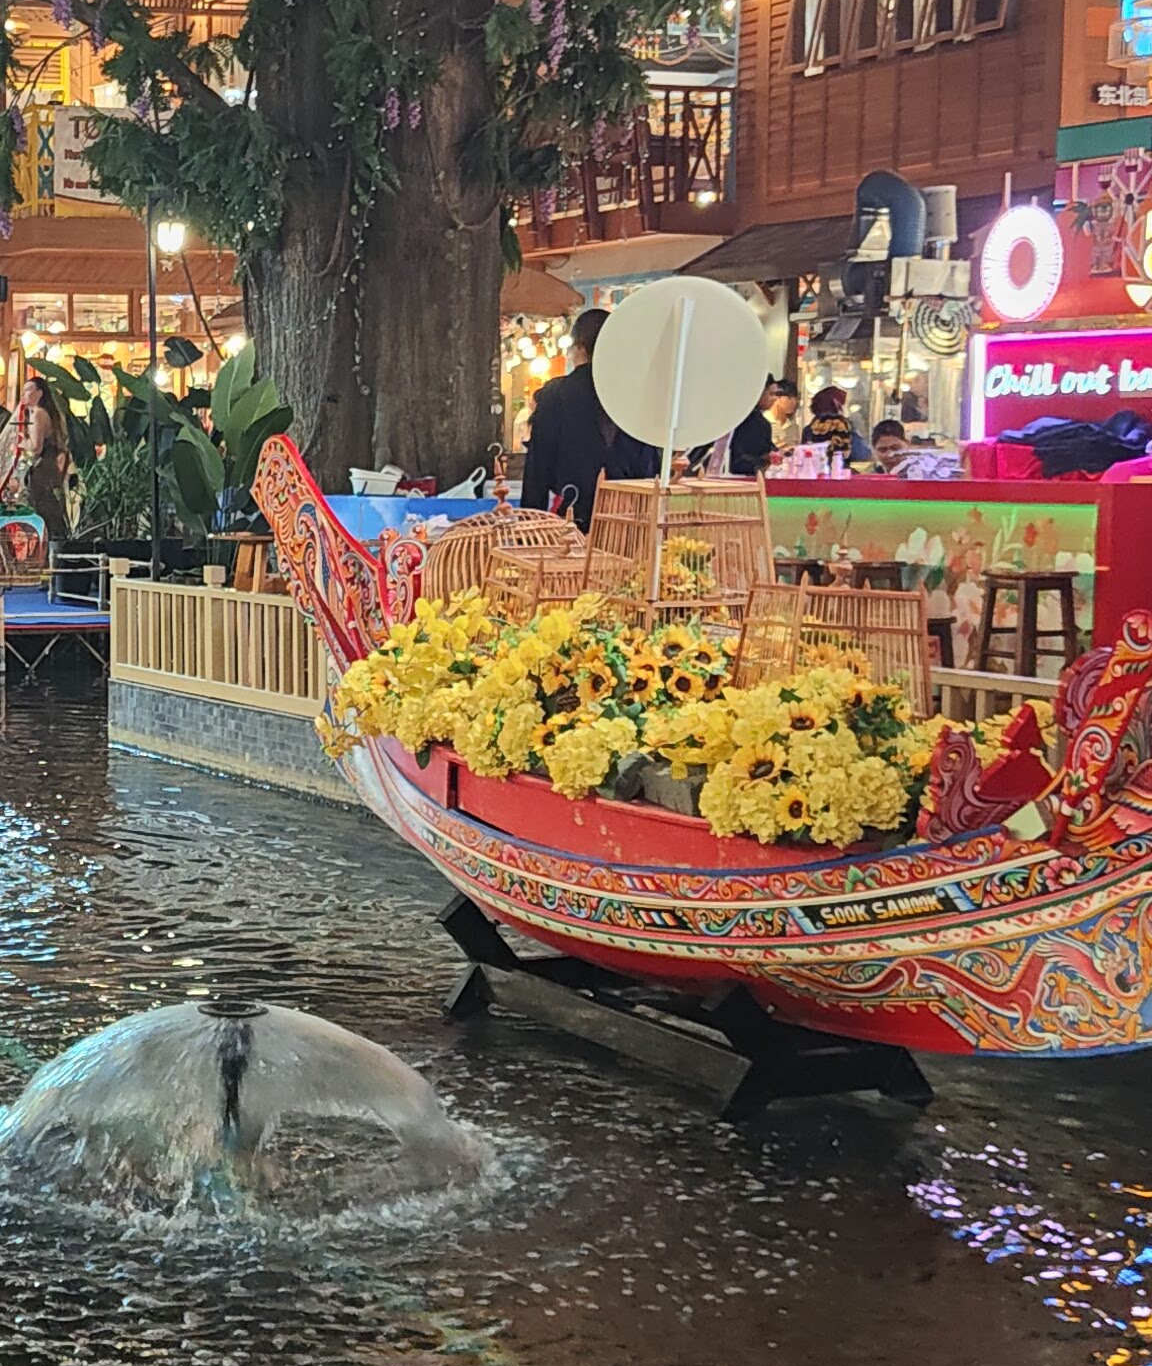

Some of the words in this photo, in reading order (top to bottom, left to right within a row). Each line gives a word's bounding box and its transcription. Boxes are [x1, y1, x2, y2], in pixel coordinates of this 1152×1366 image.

[1097, 84, 1148, 107] 东北部
[984, 361, 1058, 398] Chill
[1060, 363, 1115, 396] out
[820, 904, 872, 926] SOOK
[871, 893, 945, 920] SANOOK
